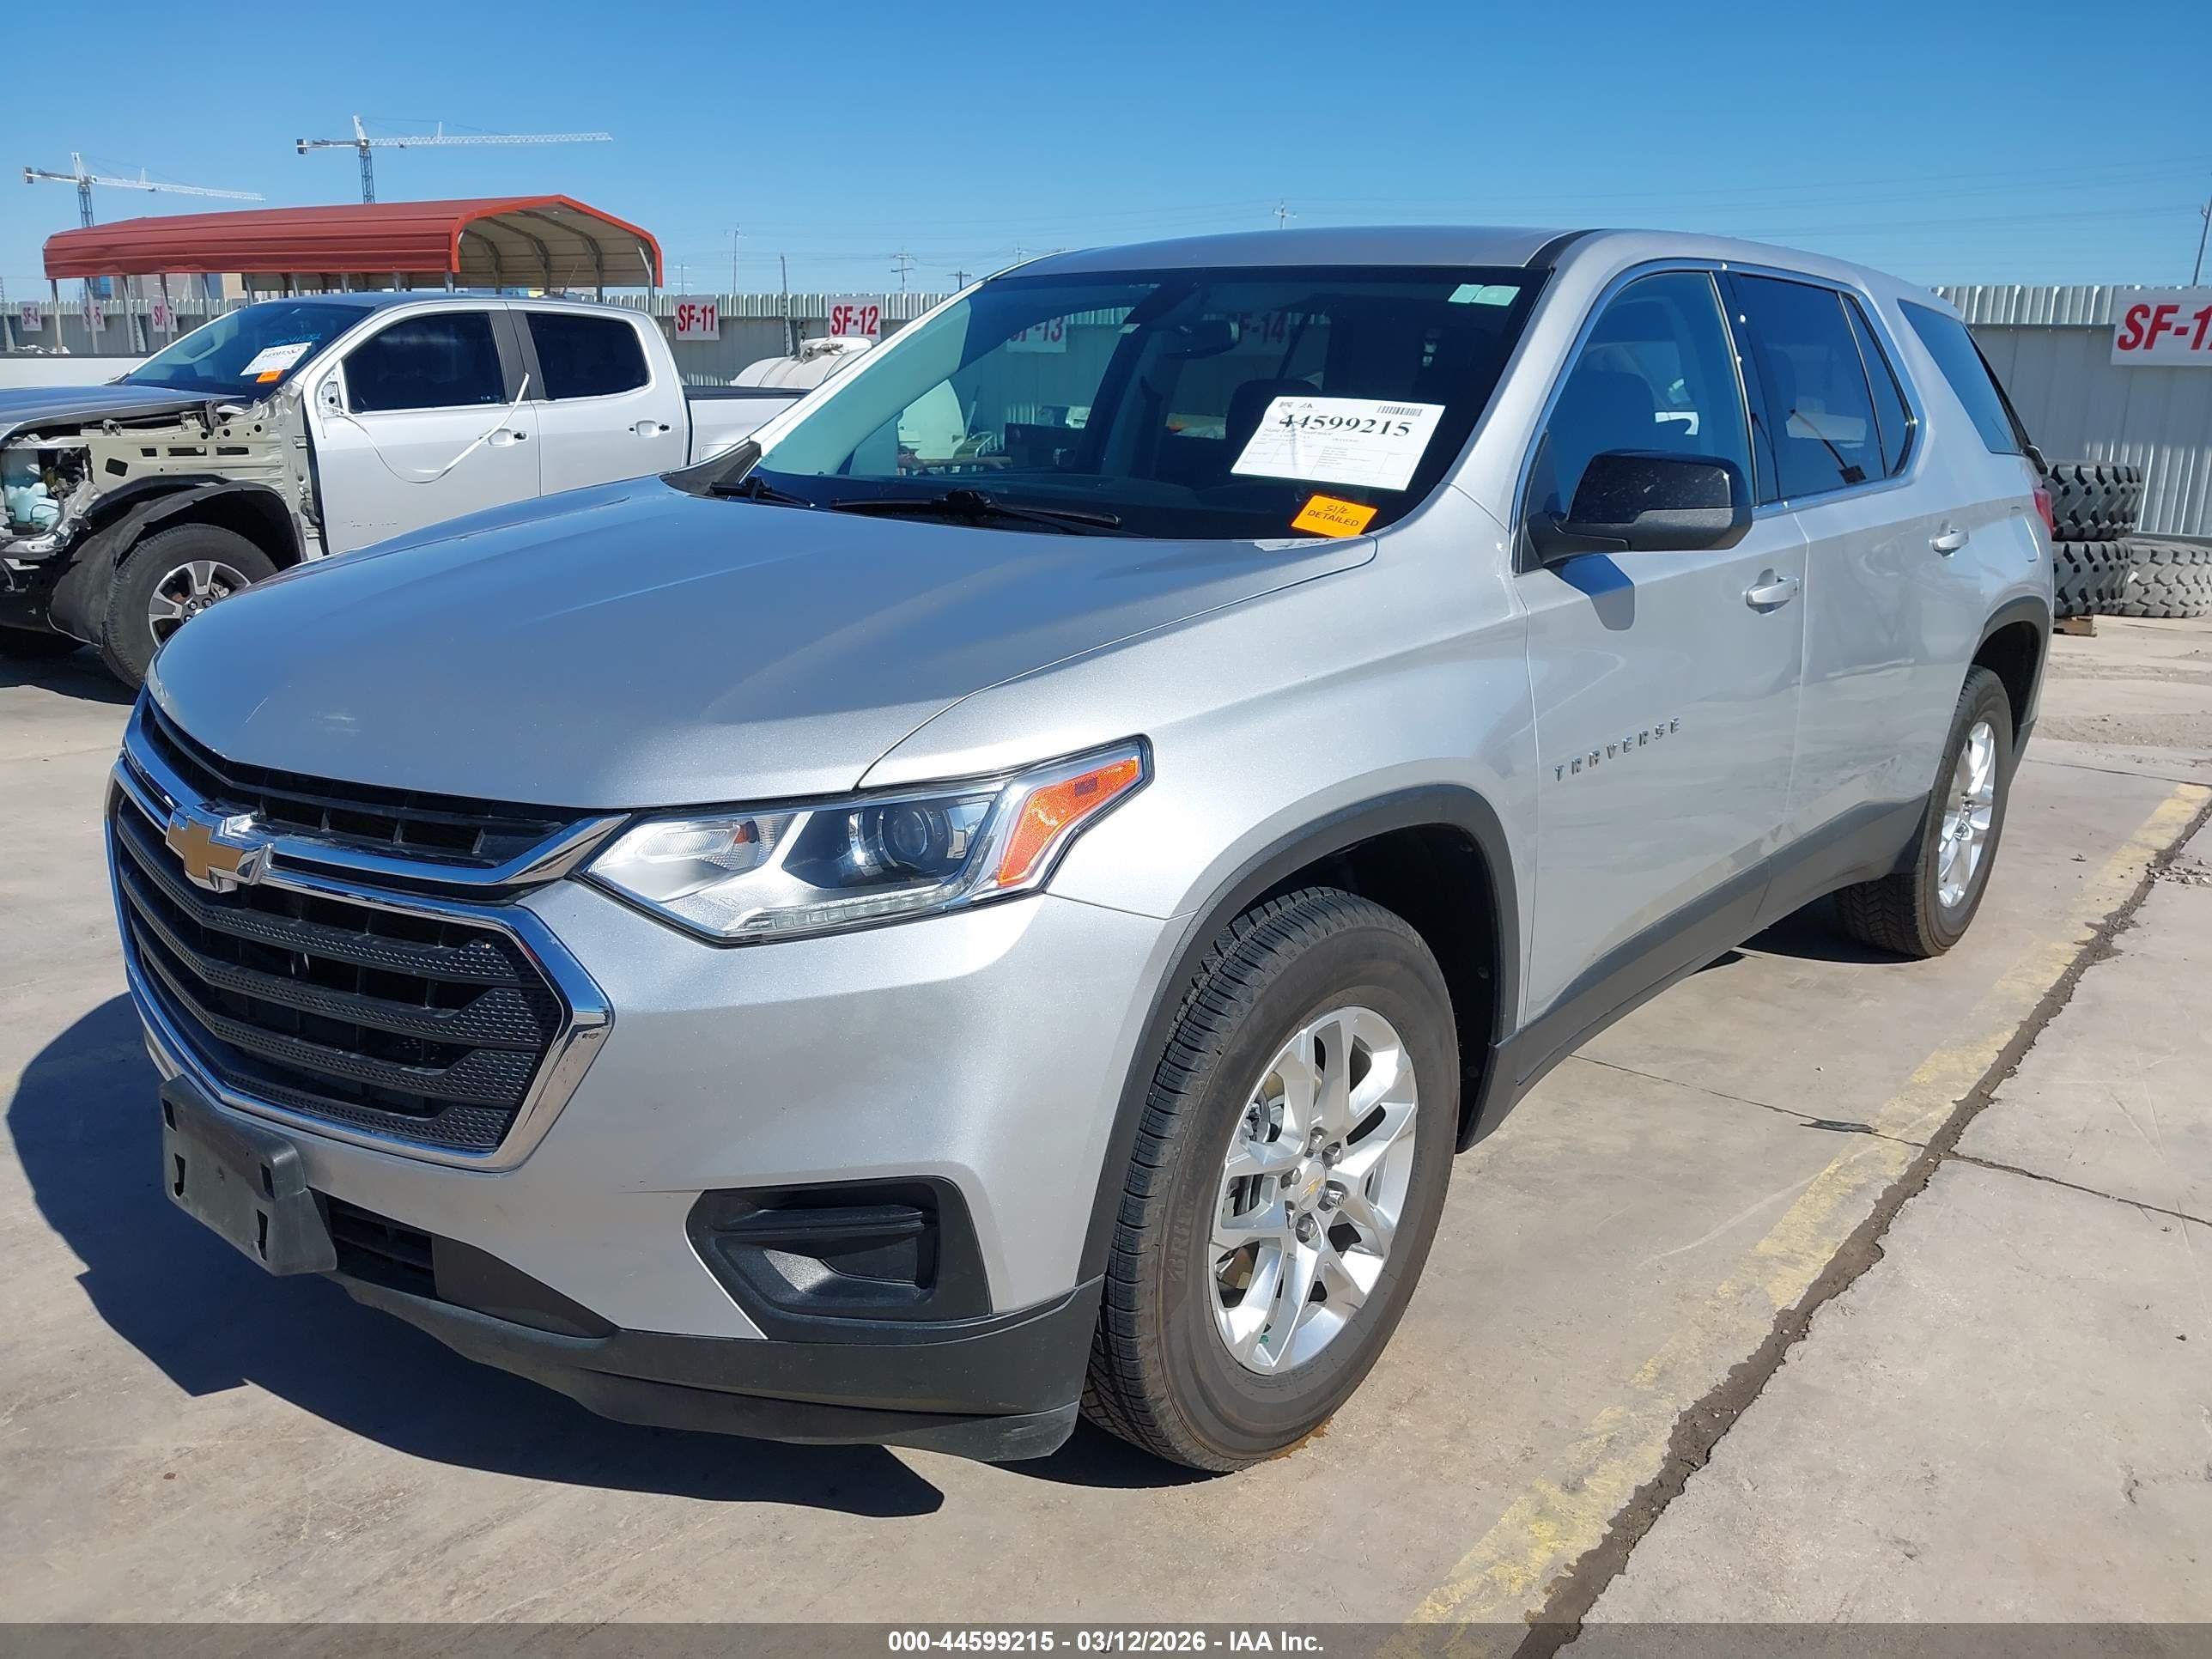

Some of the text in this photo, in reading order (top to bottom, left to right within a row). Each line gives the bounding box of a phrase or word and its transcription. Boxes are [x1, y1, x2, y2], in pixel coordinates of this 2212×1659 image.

[22, 306, 40, 325] SF-4
[83, 306, 101, 325] S-5
[677, 303, 716, 331] SF-11
[830, 305, 879, 336] SF-12
[2117, 302, 2212, 351] SF-1
[1279, 414, 1413, 437] 44599215
[1307, 509, 1360, 528] DETAILED
[1554, 717, 1680, 782] TRAVERSE
